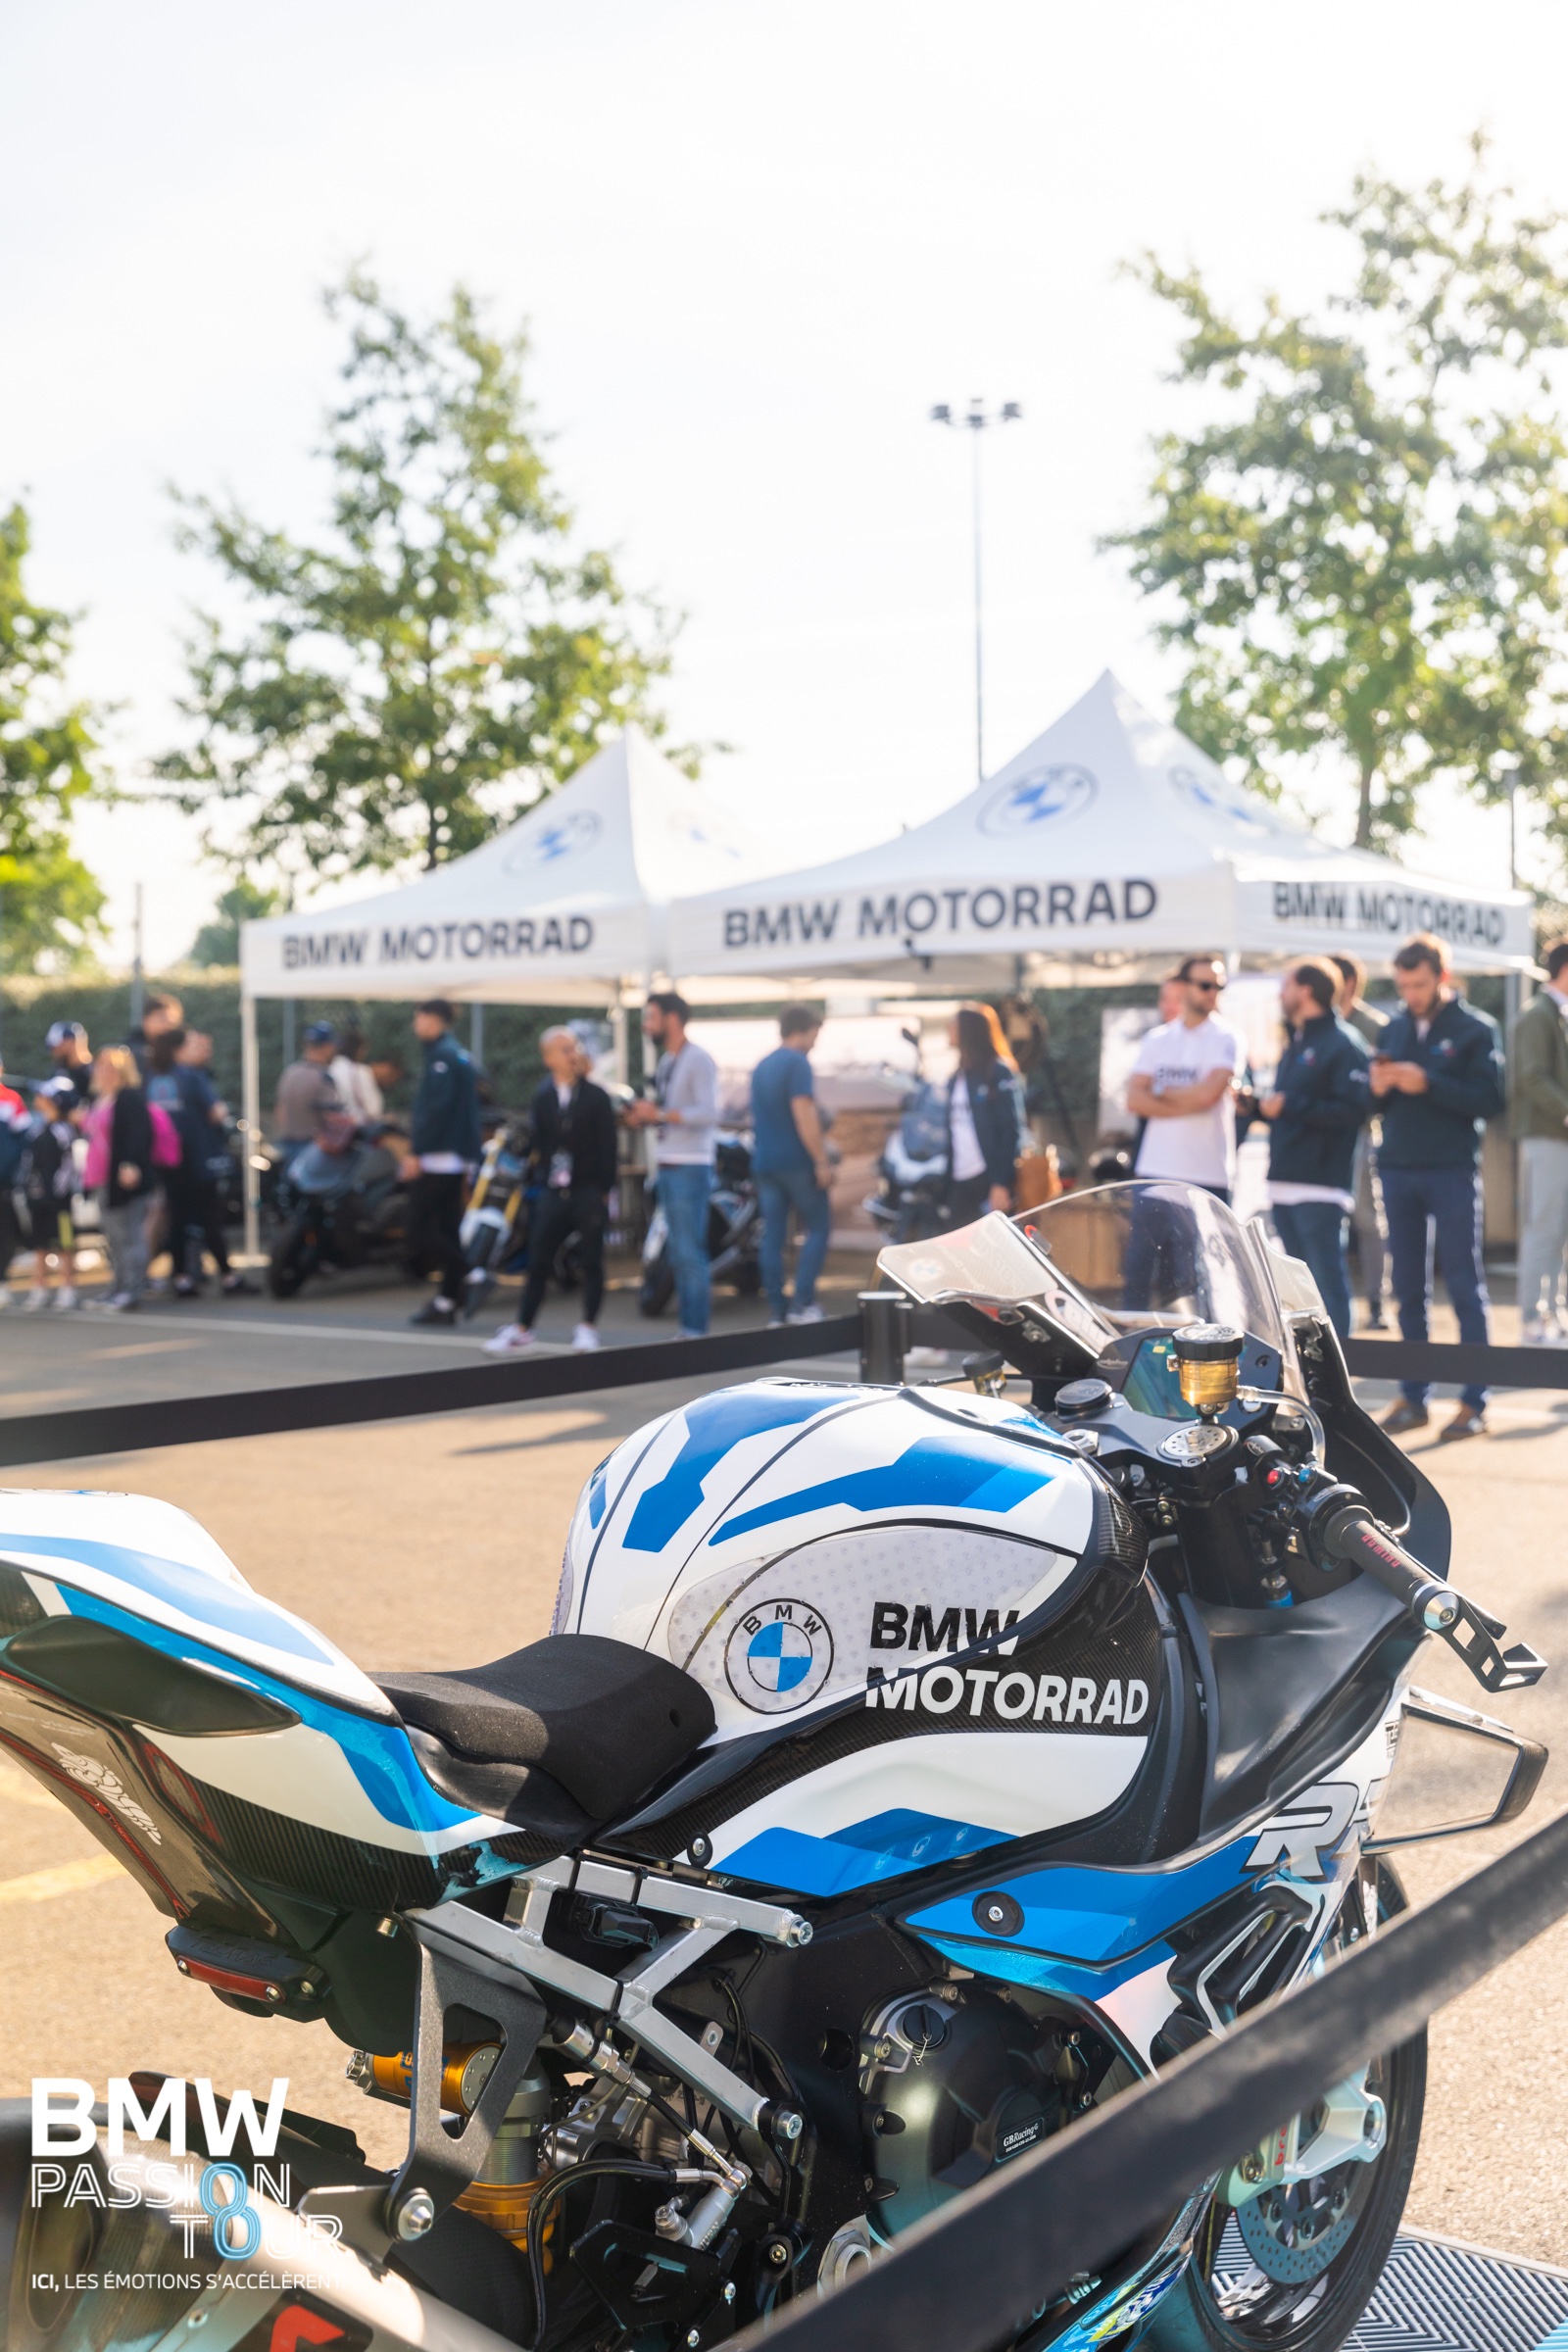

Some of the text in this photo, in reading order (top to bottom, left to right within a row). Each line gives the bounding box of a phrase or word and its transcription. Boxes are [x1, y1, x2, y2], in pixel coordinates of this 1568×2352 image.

[282, 915, 595, 969] BMW MOTORRAD
[723, 878, 1158, 949] BMW MOTORRAD
[1274, 882, 1507, 947] BMW MOTORRAD
[742, 1603, 823, 1637] BMW
[870, 1601, 1020, 1656] BMW
[865, 1665, 1150, 1725] MOTORRAD
